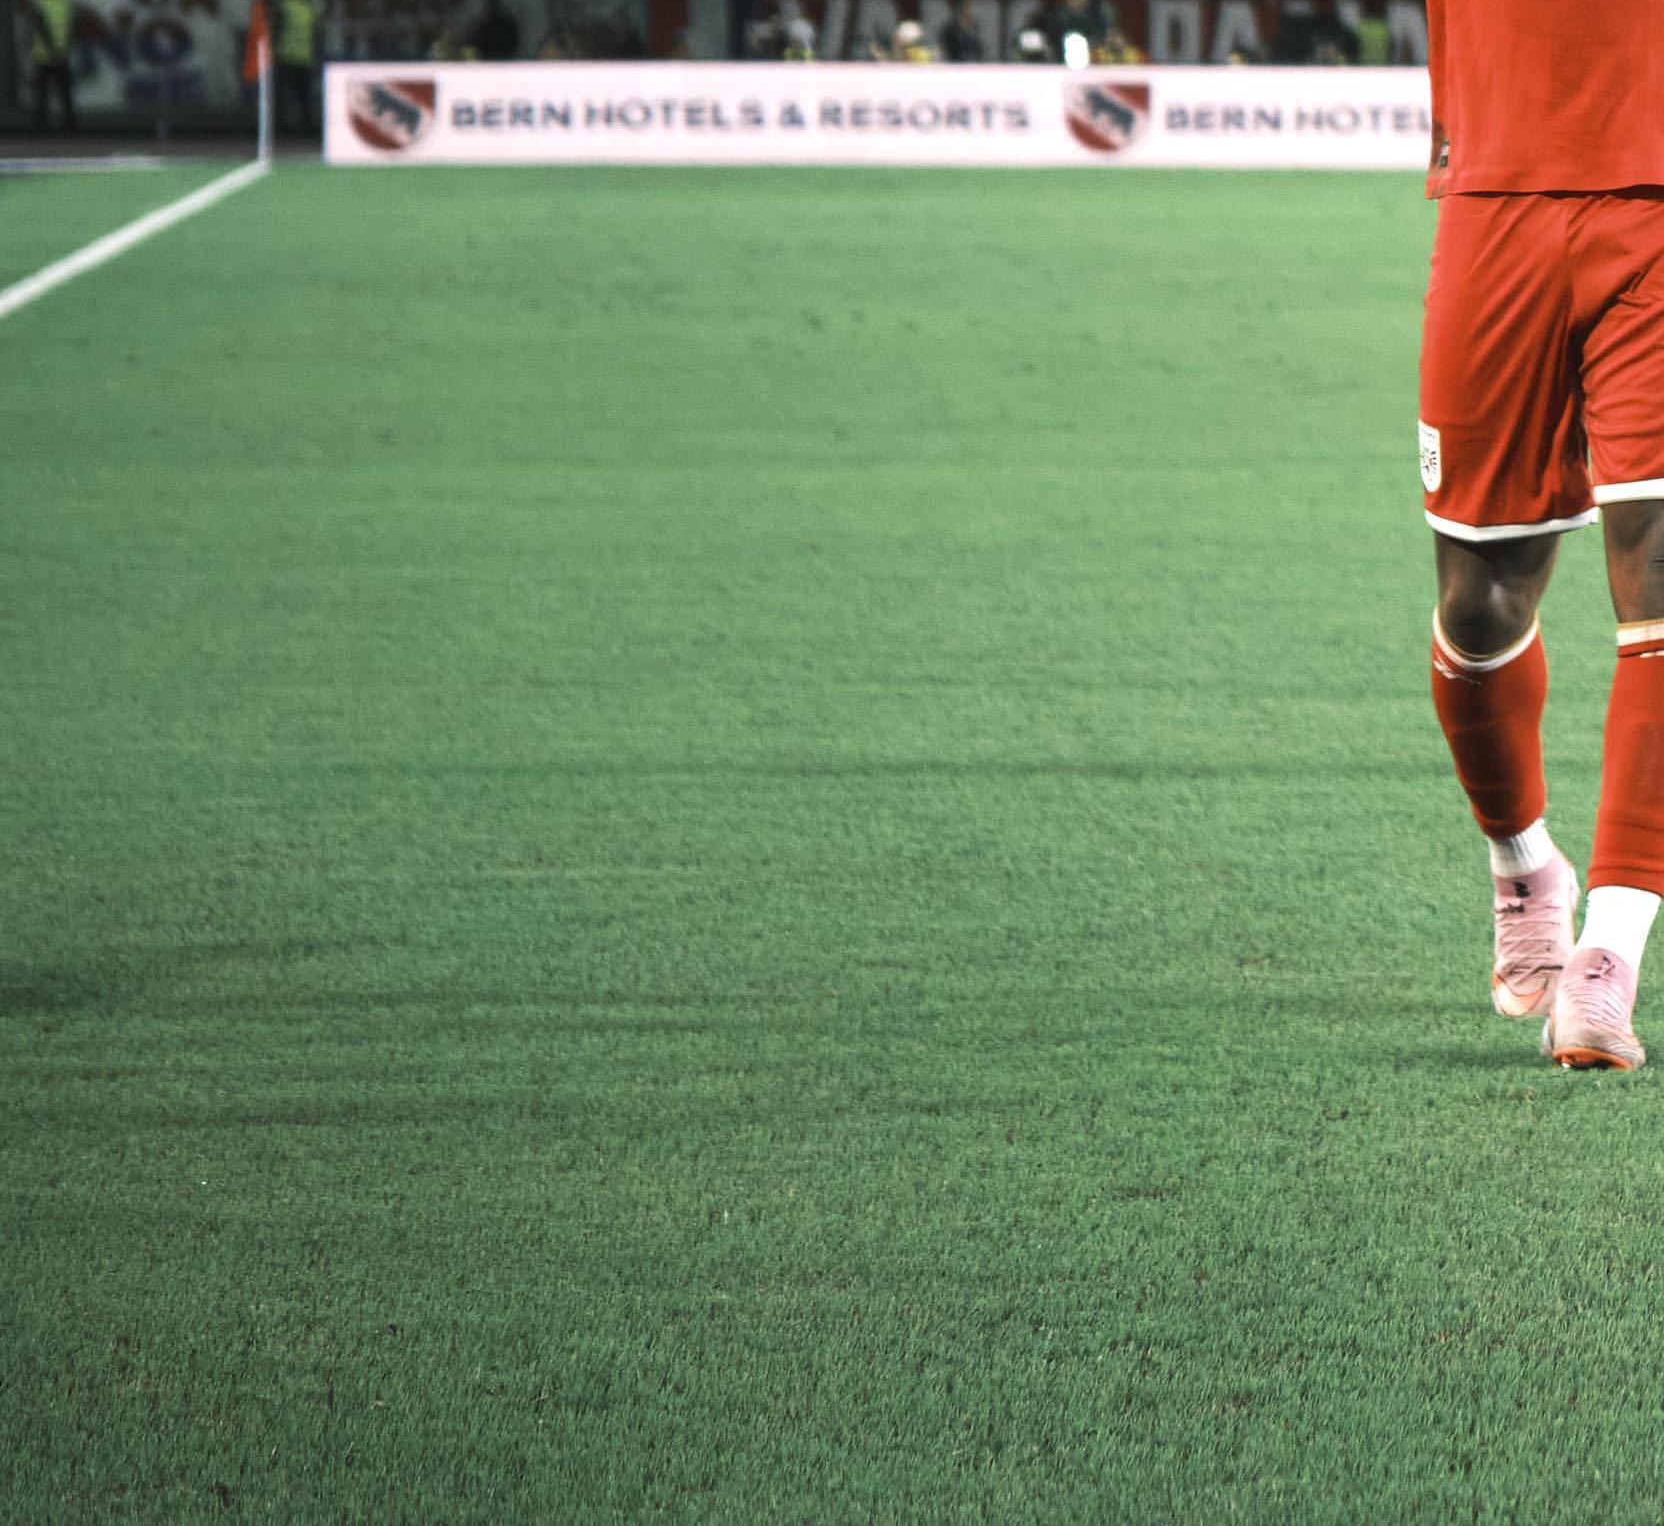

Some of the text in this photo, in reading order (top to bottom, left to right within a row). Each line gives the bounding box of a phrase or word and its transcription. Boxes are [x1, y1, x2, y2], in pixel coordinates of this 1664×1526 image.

[452, 98, 1031, 132] BERN HOTELS & RESORTS
[1167, 105, 1431, 134] BERN HOTEL
